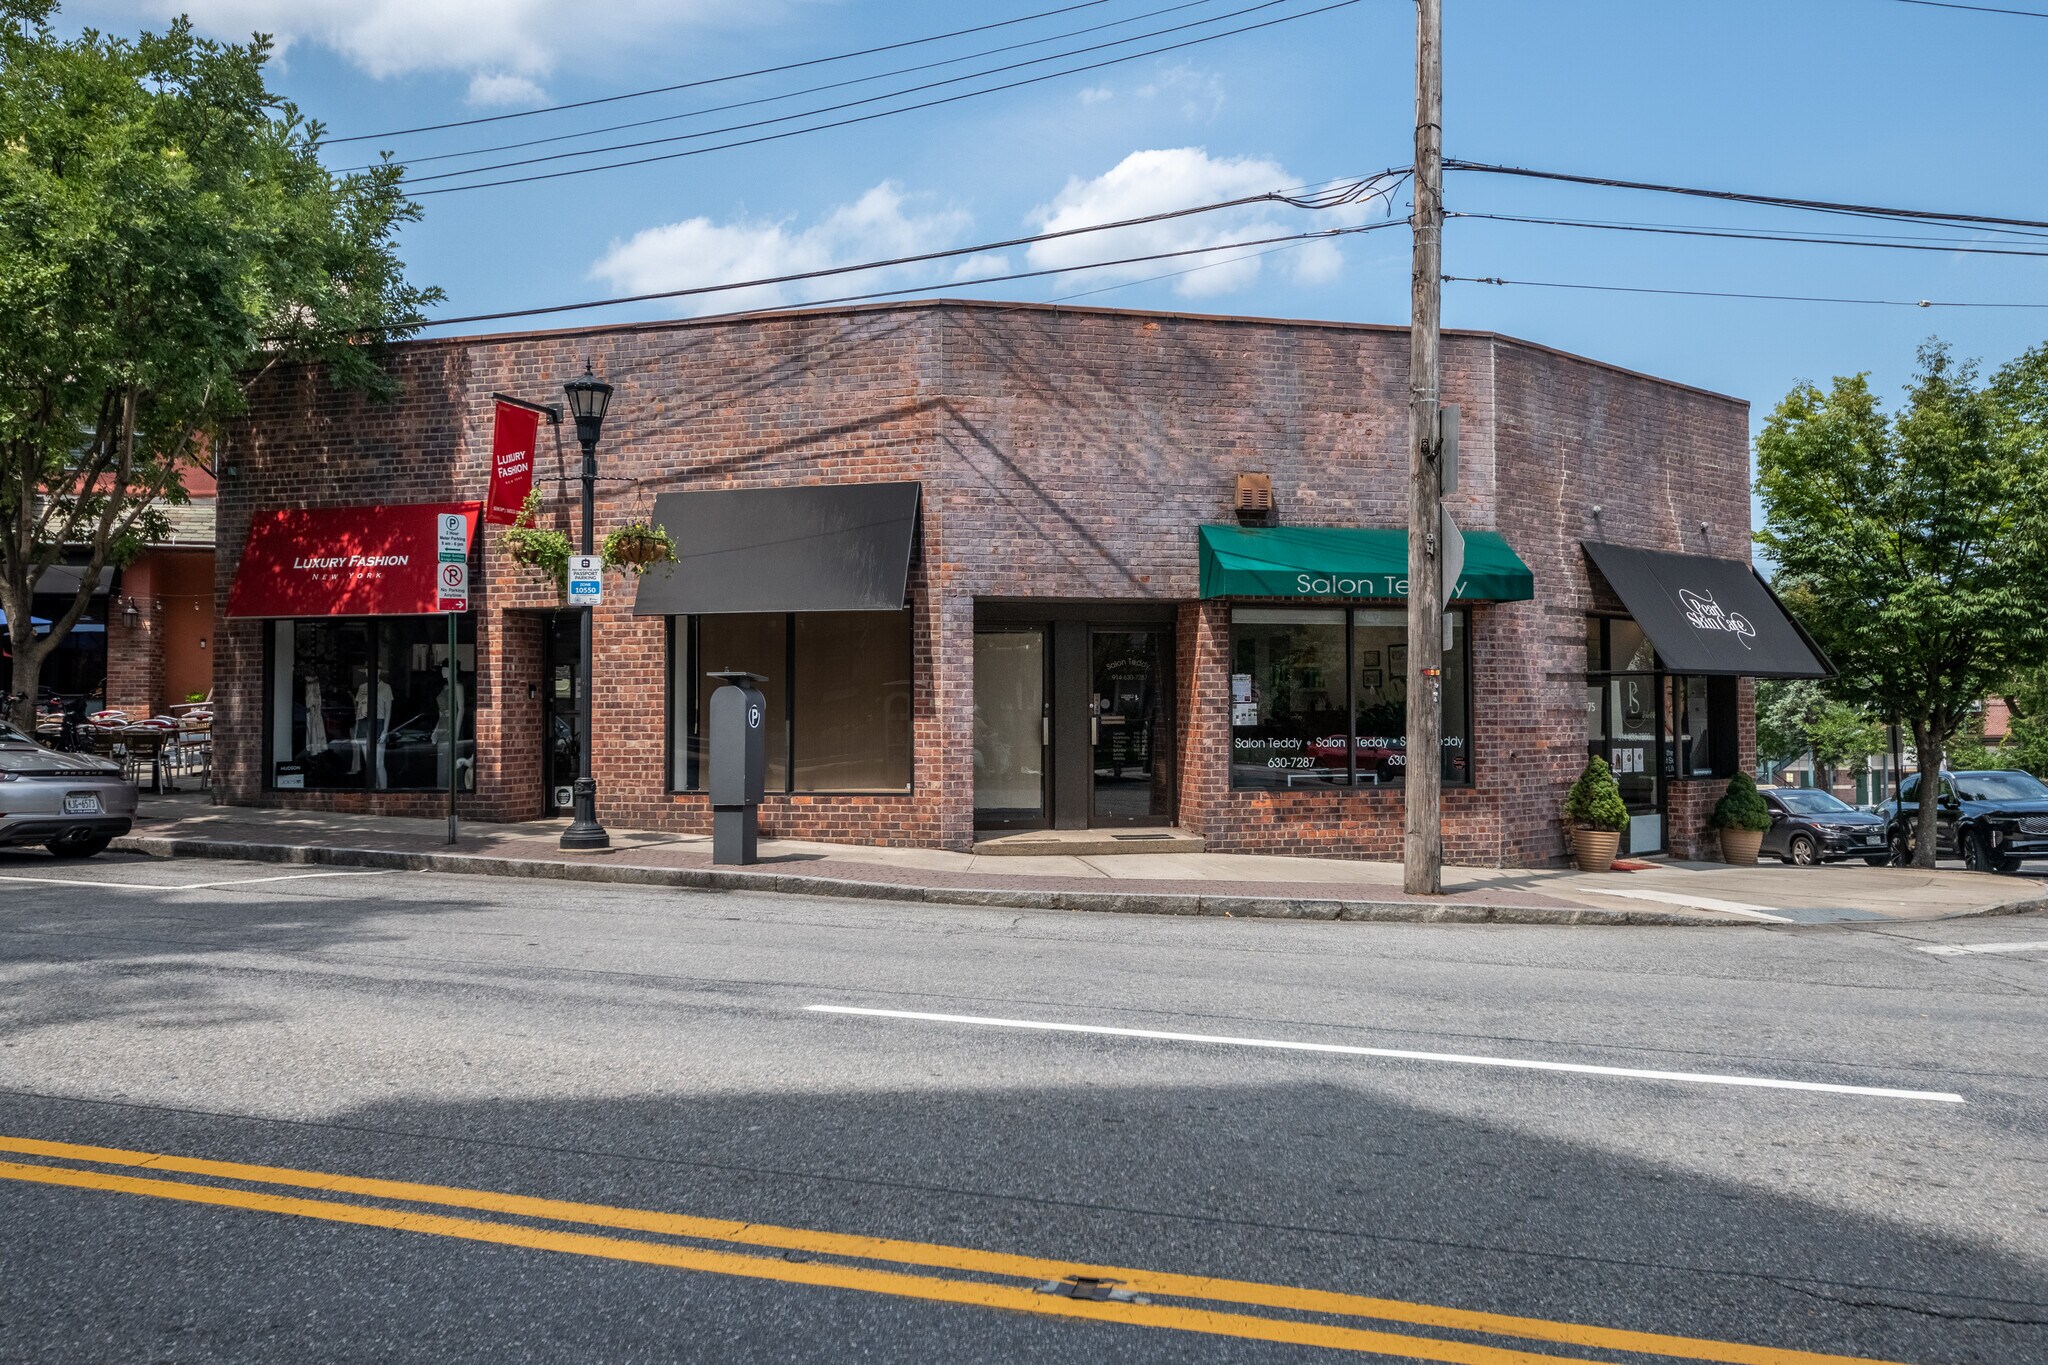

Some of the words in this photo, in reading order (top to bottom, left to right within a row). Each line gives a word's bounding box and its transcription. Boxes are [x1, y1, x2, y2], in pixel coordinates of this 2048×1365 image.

[497, 451, 526, 465] LUXURY
[498, 463, 528, 478] FASHION
[293, 558, 347, 569] LUXURY
[348, 555, 409, 567] FASHION
[1297, 574, 1374, 594] Salon
[1384, 576, 1467, 599] Tey
[1686, 611, 1721, 630] Skin
[1106, 660, 1127, 670] Salon
[1234, 737, 1266, 748] Salon
[1268, 737, 1302, 751] Teddy
[1316, 736, 1346, 748] Salon
[1356, 736, 1389, 748] Teddy
[1268, 757, 1316, 768] 630-7287
